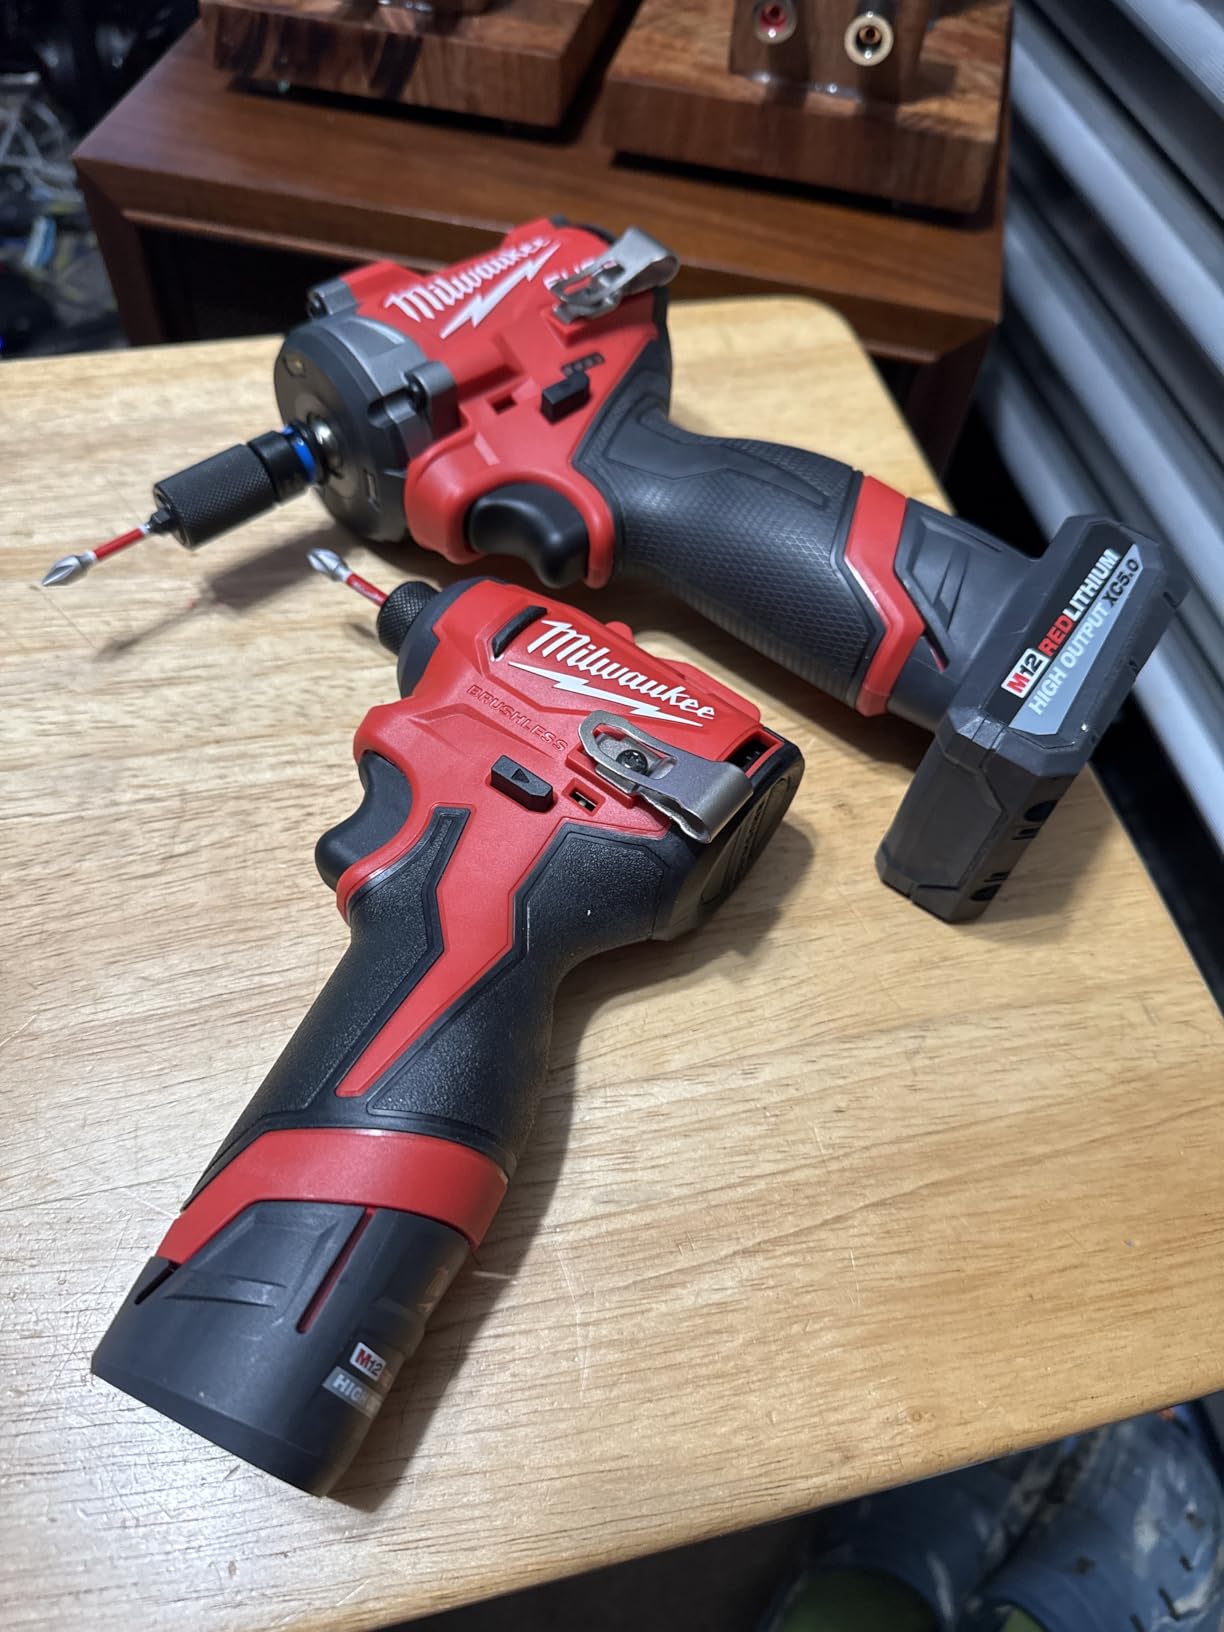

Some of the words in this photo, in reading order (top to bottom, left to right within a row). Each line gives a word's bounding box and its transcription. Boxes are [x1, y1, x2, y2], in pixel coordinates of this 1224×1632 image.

[383, 236, 551, 323] Milwaukee
[526, 618, 716, 721] Milwaukee
[1006, 653, 1044, 694] M12
[1028, 666, 1068, 716] HIGH
[1060, 602, 1110, 669] OUTPUT
[1102, 558, 1139, 609] XC5.0
[465, 684, 570, 752] BRUSHLESS
[354, 1347, 384, 1377] M12
